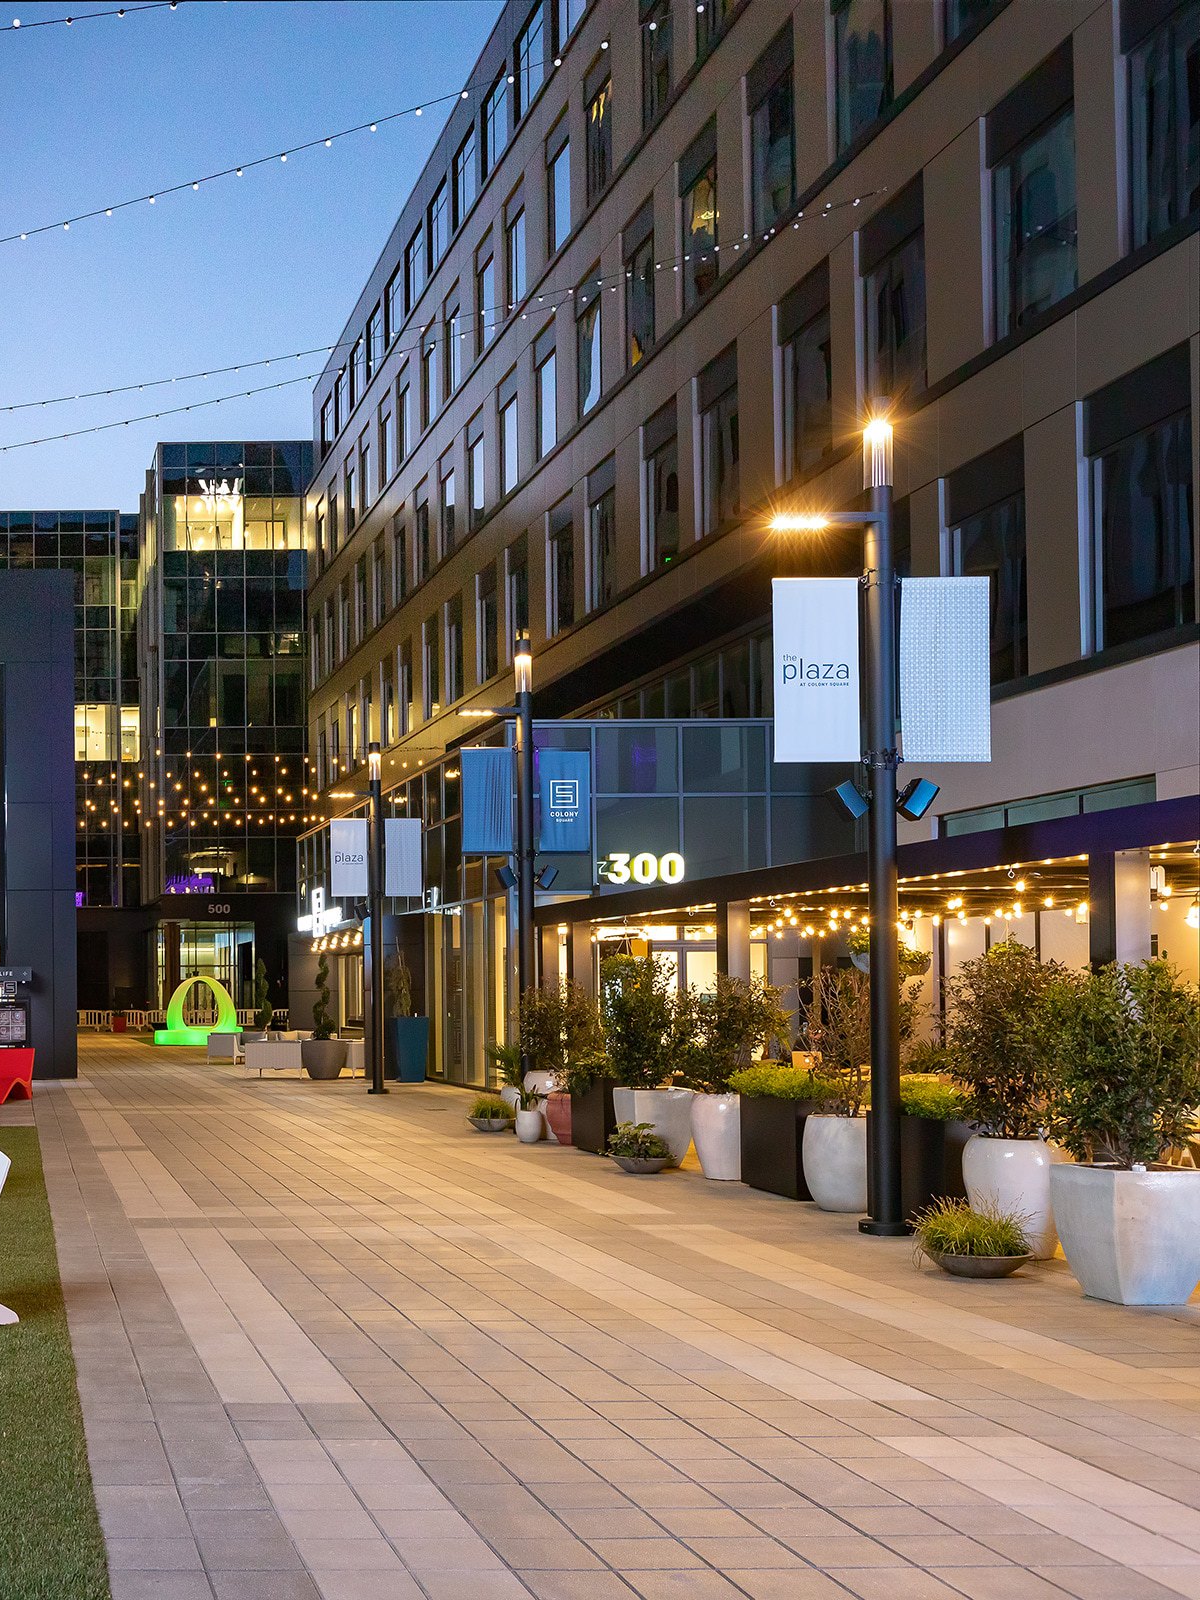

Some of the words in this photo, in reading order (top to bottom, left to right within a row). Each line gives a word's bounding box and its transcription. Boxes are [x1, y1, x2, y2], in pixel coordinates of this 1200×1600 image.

[783, 658, 849, 684] plaza
[335, 852, 364, 865] plaza
[607, 852, 685, 885] 300
[208, 904, 231, 914] 500
